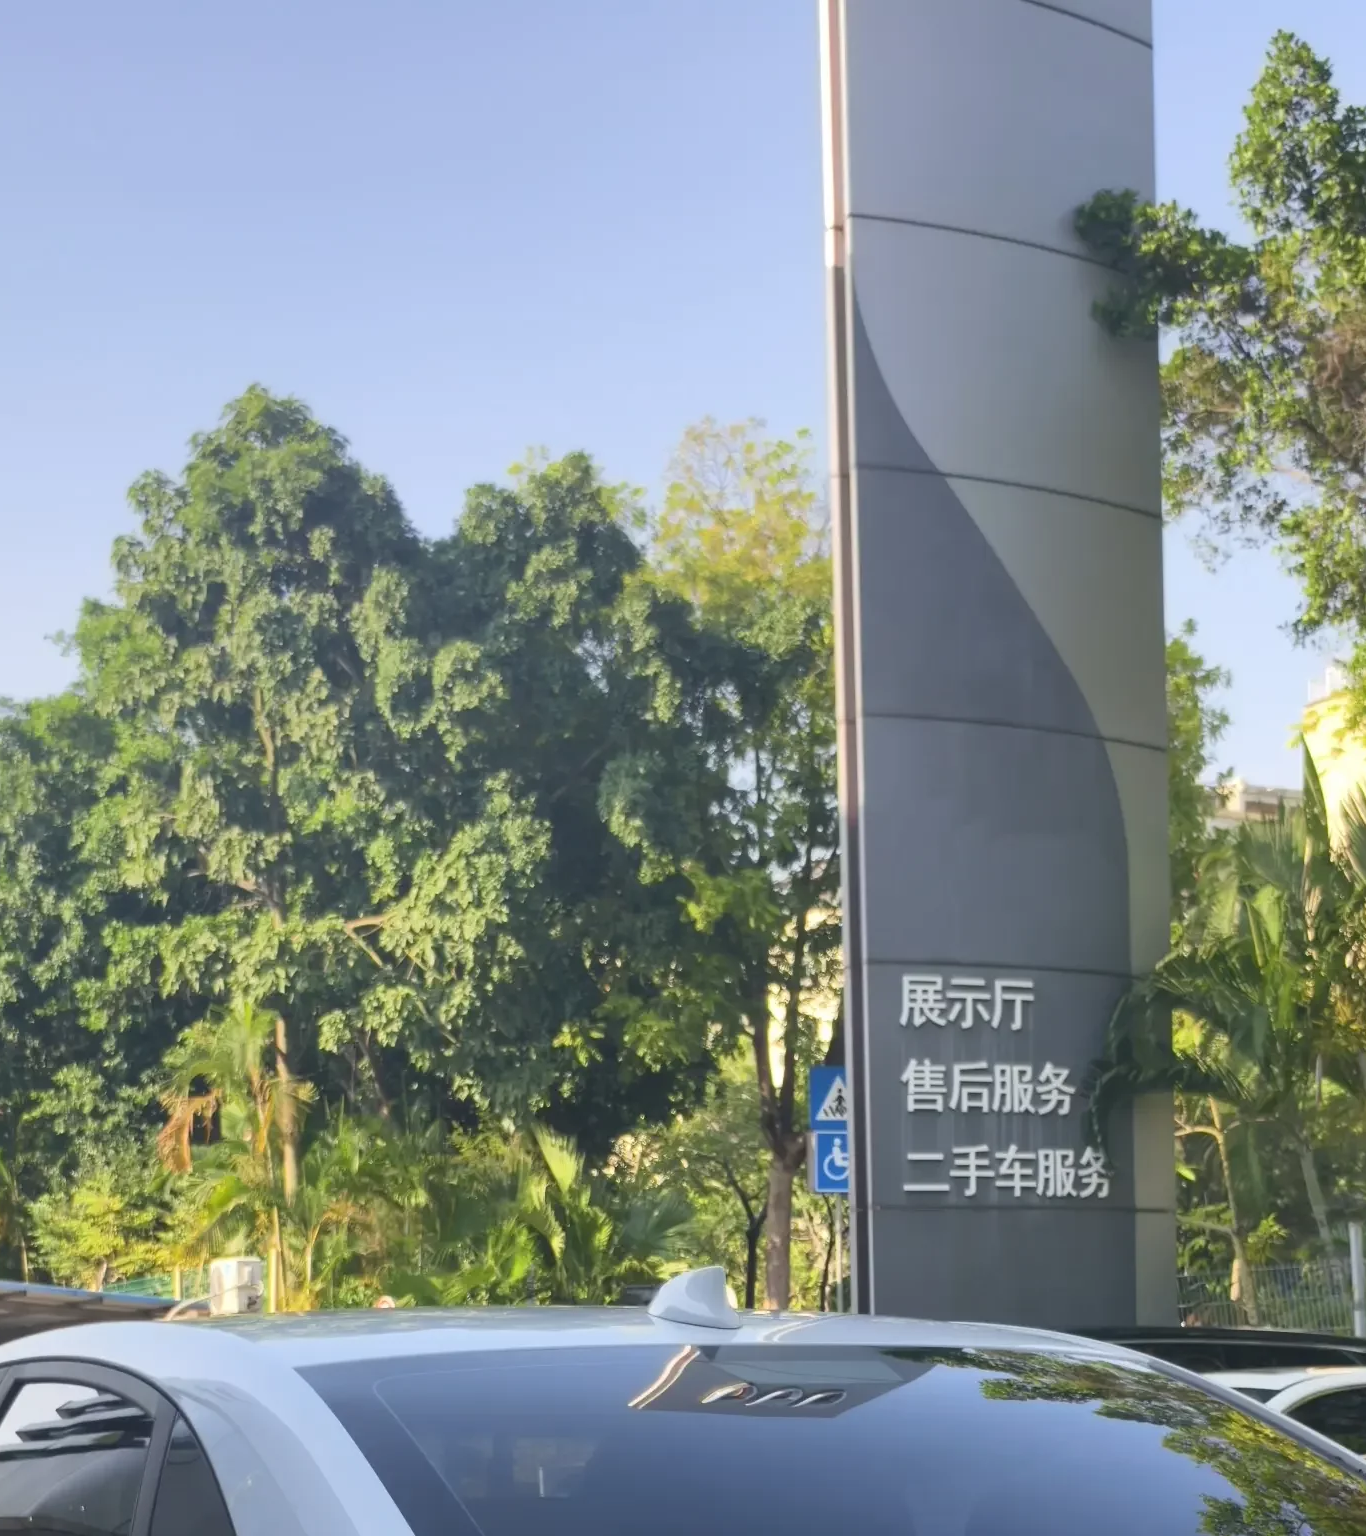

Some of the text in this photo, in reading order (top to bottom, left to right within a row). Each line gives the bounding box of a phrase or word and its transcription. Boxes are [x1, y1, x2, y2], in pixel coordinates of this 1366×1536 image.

[899, 974, 1035, 1031] 展示厅
[900, 1058, 1076, 1116] 售后服务
[902, 1144, 1111, 1199] 二手车服务
